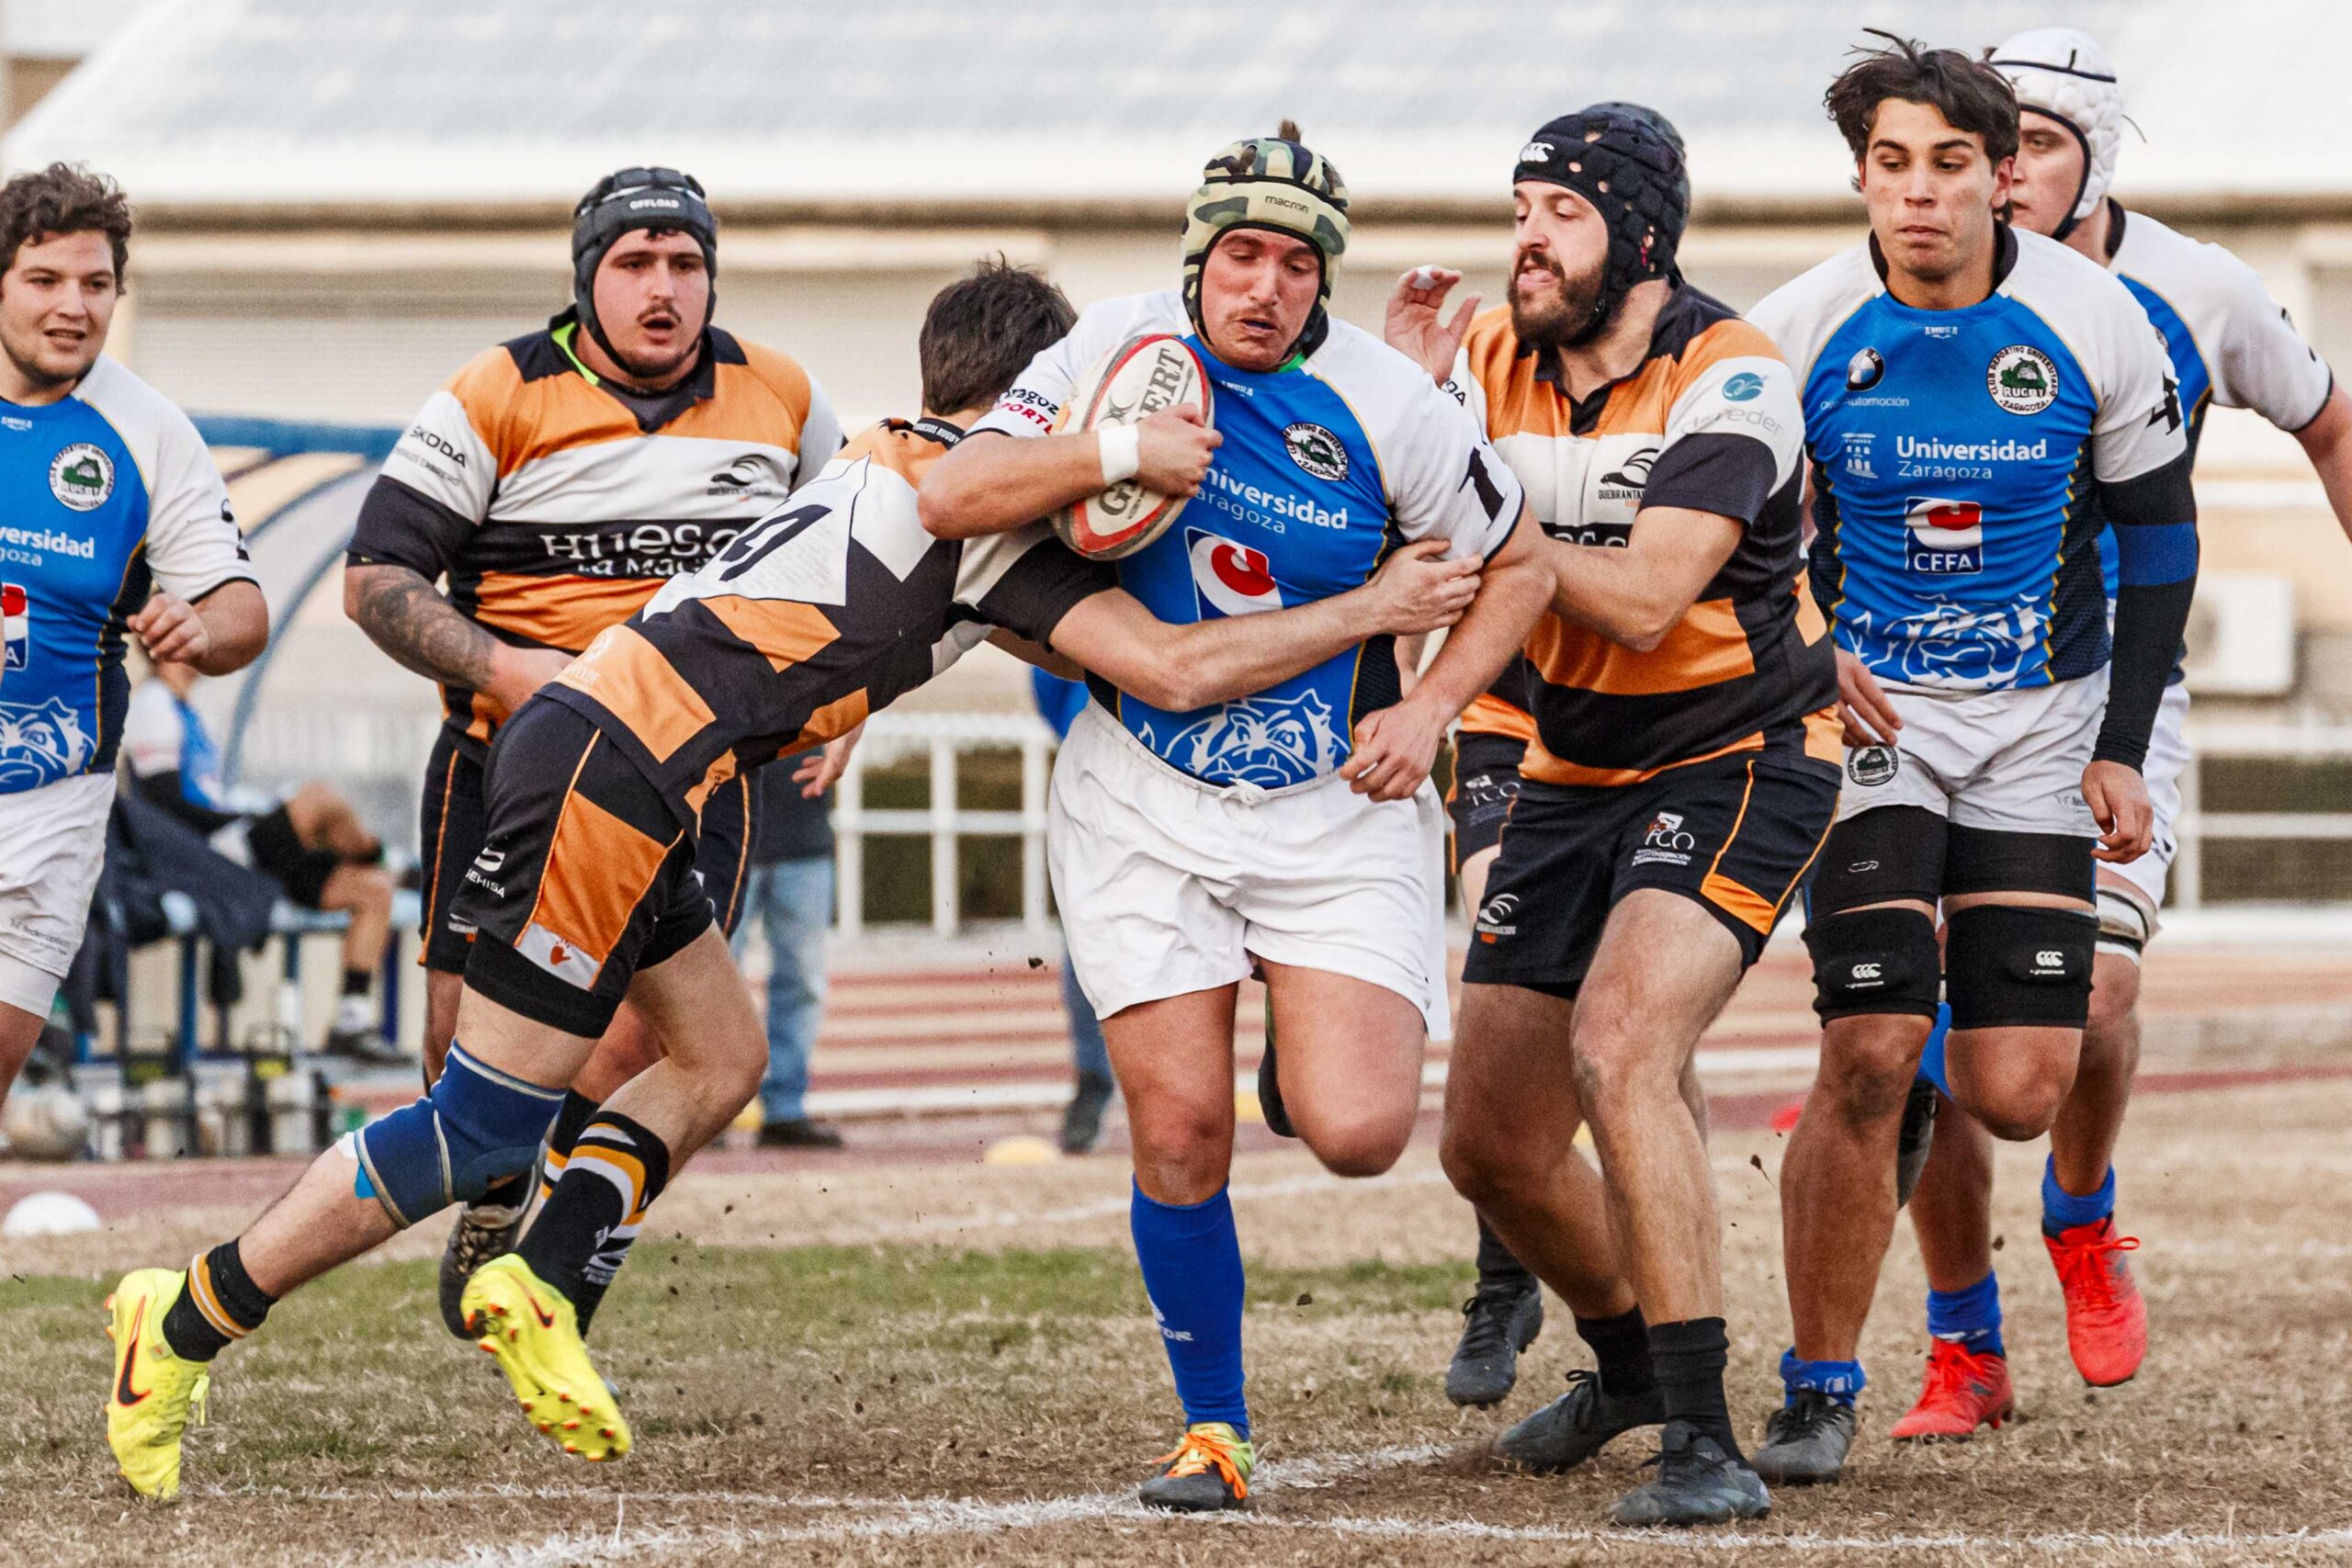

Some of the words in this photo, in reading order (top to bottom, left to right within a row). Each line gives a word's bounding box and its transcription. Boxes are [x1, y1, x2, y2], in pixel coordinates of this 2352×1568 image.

[1264, 195, 1309, 213] macron
[2002, 387, 2046, 399] RUGBY
[1896, 435, 2048, 462] Universidad
[1897, 460, 1994, 481] Zaragoza
[1203, 467, 1348, 530] niversidad
[1194, 487, 1286, 536] aragoza
[1913, 552, 1974, 572] CEFA
